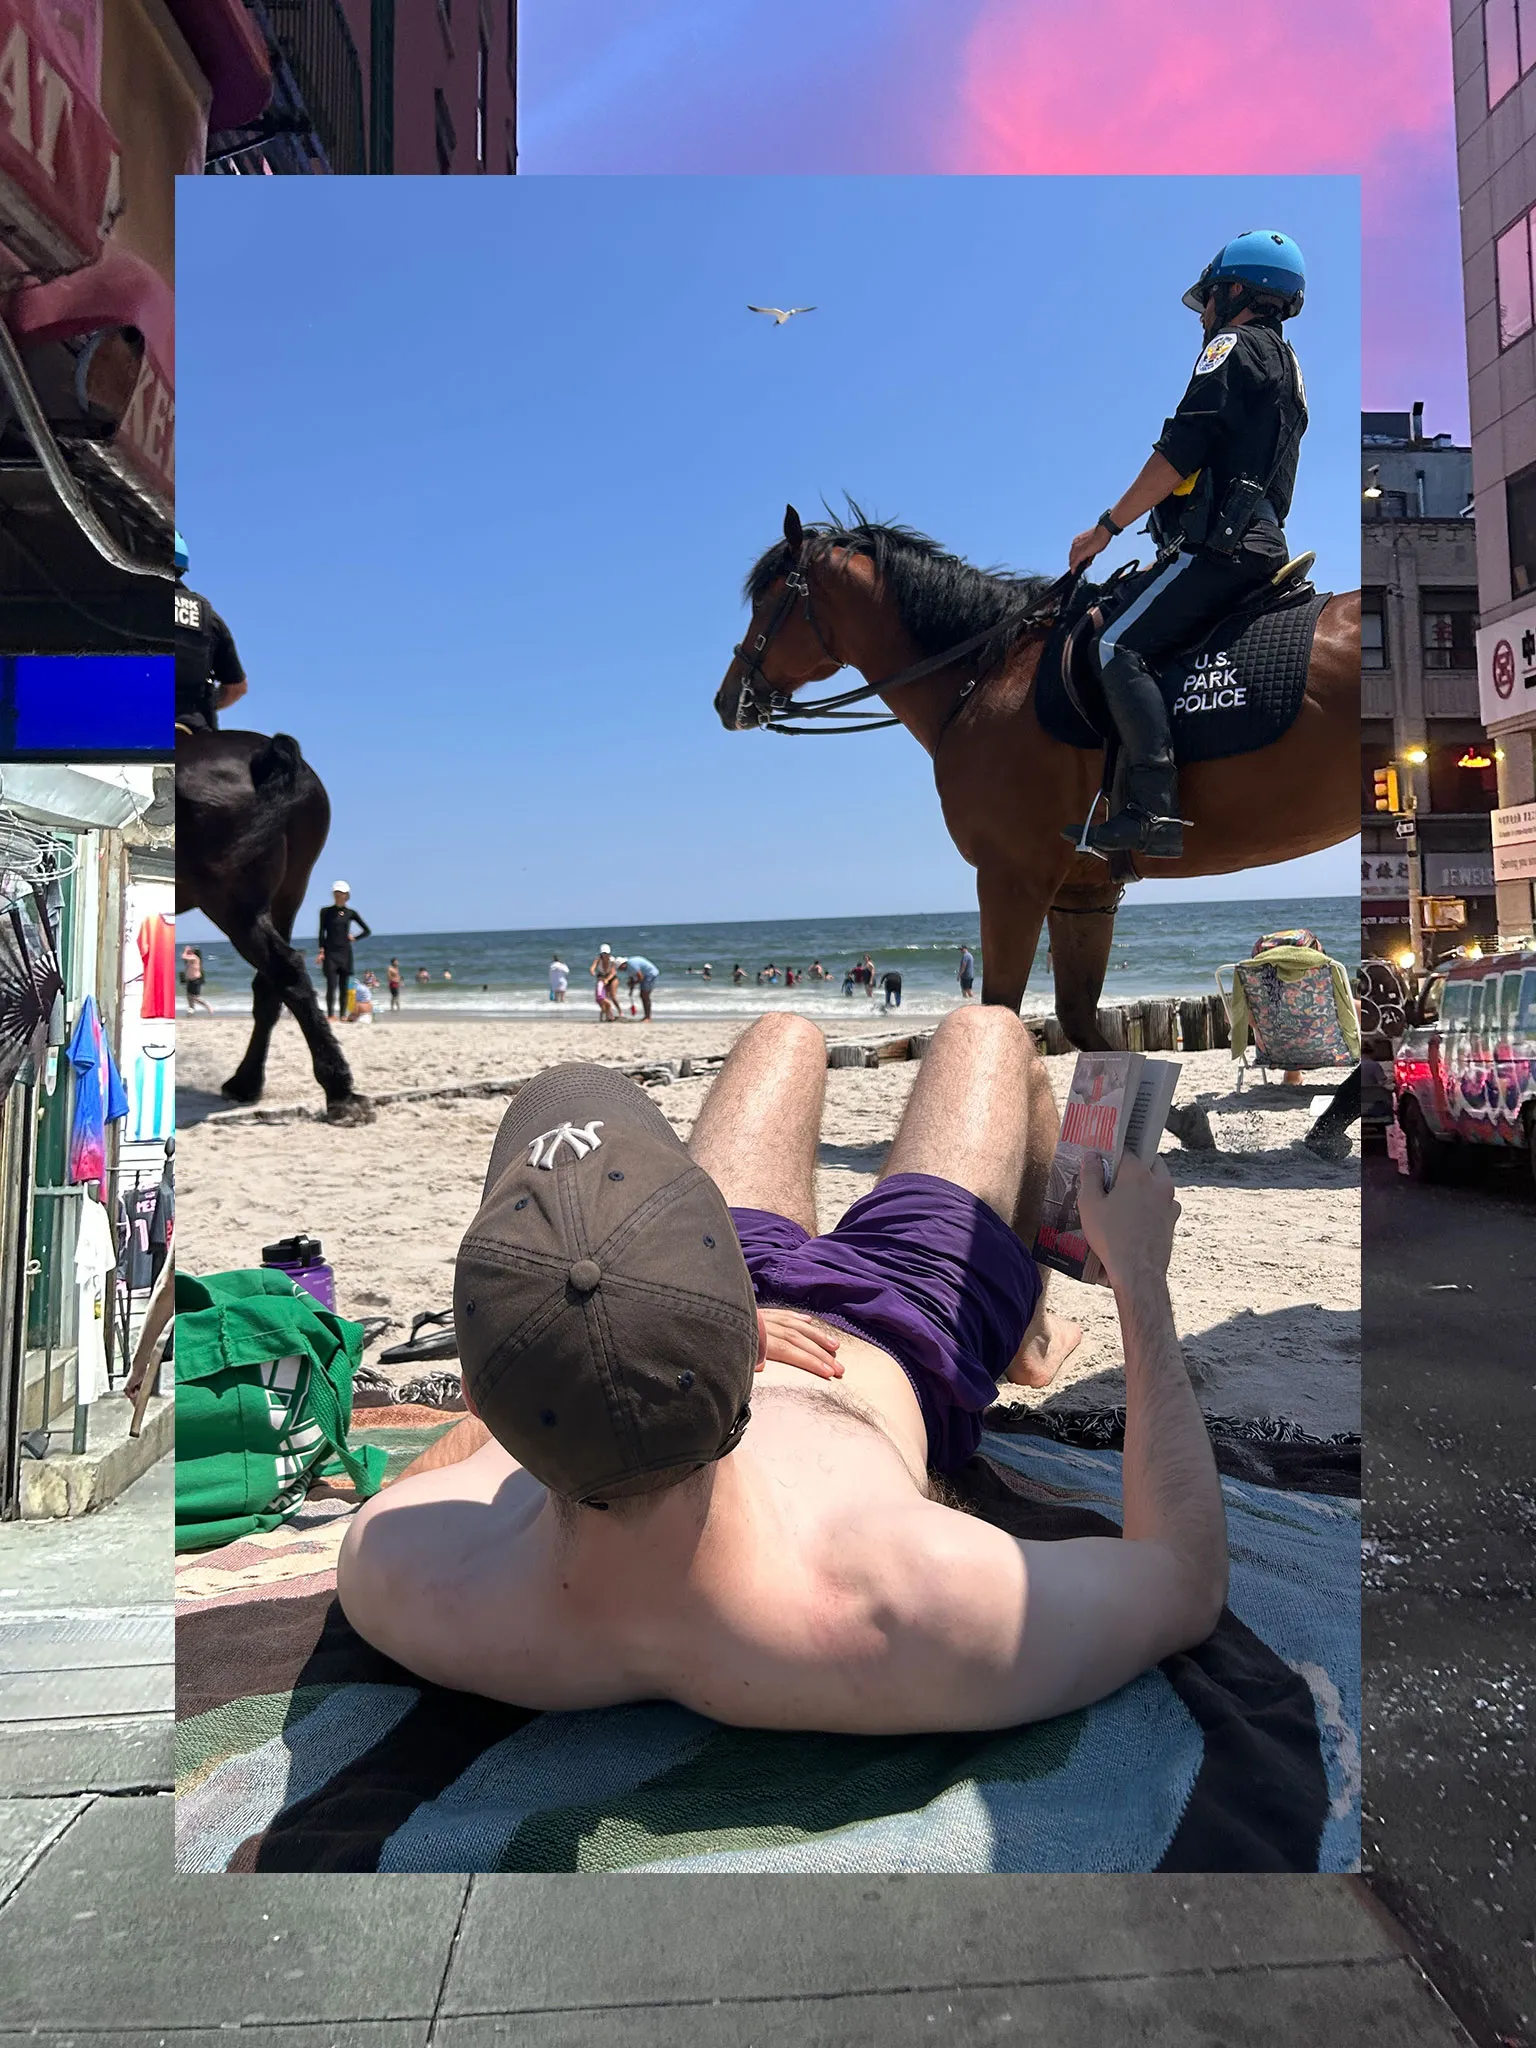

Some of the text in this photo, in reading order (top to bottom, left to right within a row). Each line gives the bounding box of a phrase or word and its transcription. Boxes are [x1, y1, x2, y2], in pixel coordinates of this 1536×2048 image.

[1195, 651, 1231, 669] U.S.
[1183, 668, 1238, 692] PARK
[1173, 687, 1247, 716] POLICE
[1061, 1102, 1117, 1152] DIRECTOR
